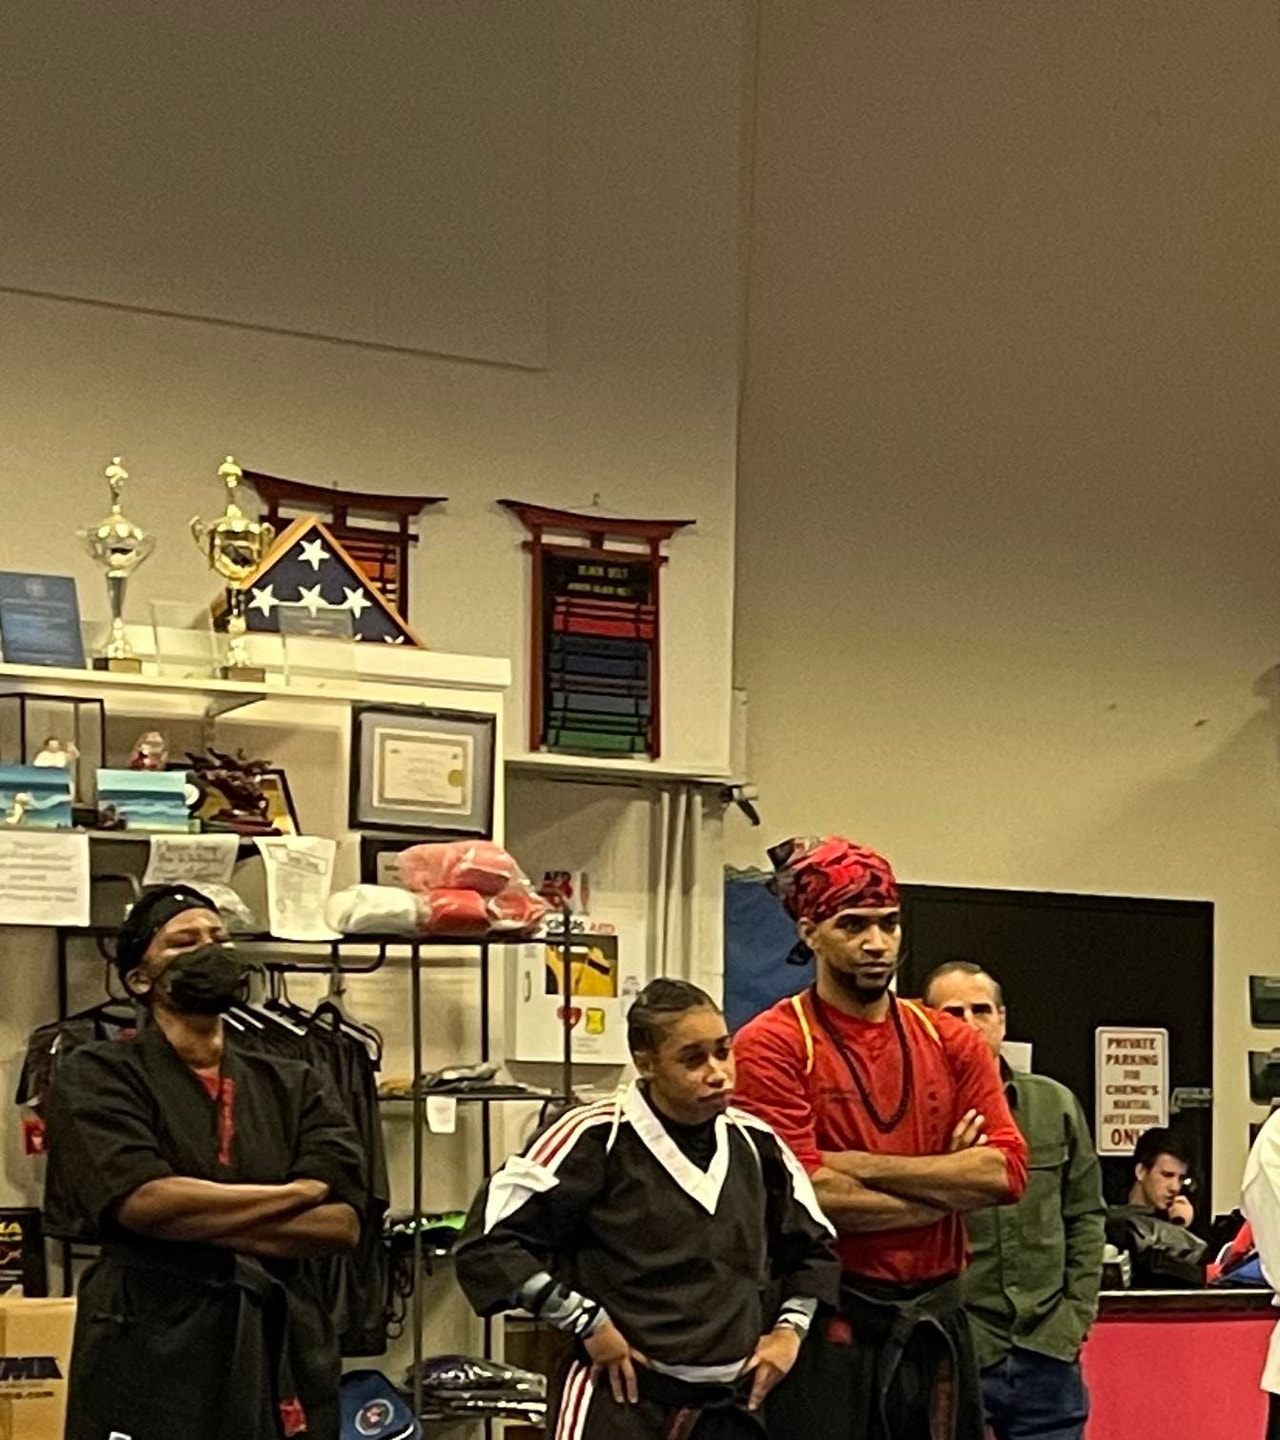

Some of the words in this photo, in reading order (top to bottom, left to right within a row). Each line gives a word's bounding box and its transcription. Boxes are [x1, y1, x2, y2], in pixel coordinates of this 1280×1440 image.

[1107, 1038, 1156, 1050] PRIVATE
[1105, 1054, 1159, 1066] PARKING
[1111, 1128, 1140, 1146] ON
